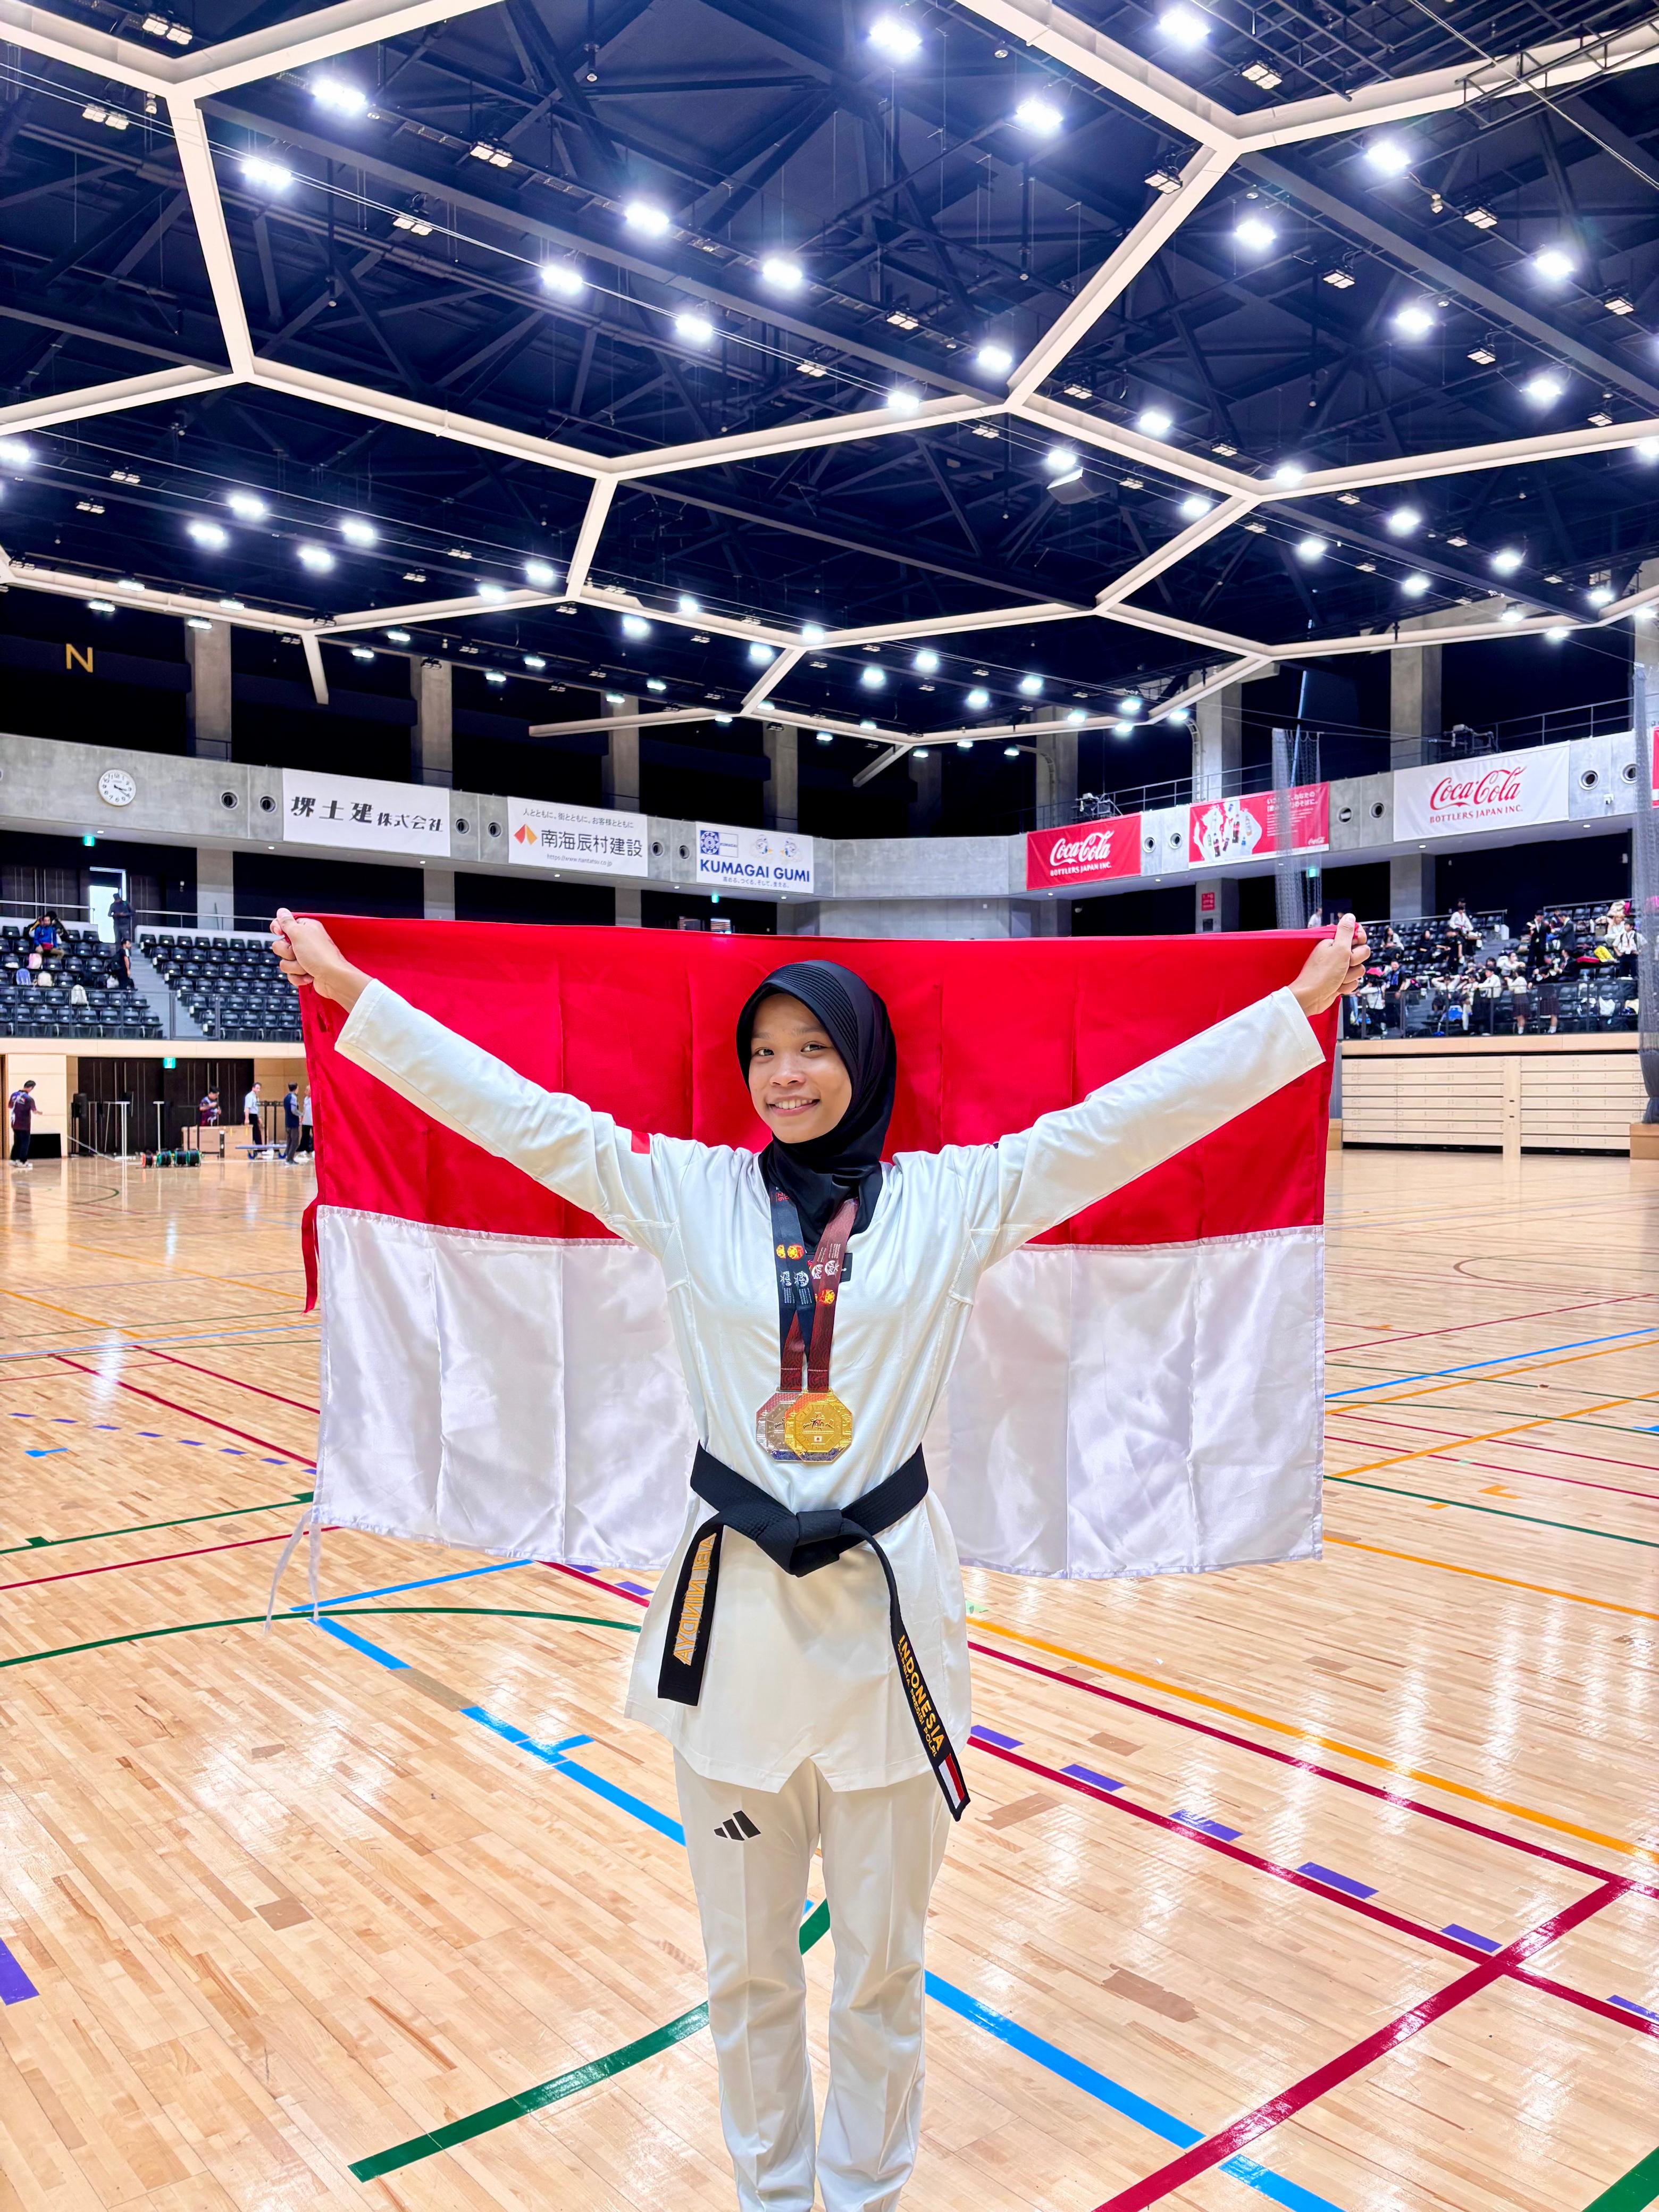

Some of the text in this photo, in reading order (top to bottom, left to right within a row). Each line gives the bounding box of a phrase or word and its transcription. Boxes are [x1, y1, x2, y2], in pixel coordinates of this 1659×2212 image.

[66, 643, 93, 673] N
[1430, 805, 1523, 824] BOTTLERS JAPAN INC.
[541, 830, 643, 857] 南海辰村建設
[700, 859, 810, 883] KUMAGAI GUMI
[1050, 866, 1080, 876] BOTTLERS
[1080, 863, 1099, 874] JAPAN
[899, 1635, 944, 1751] INDONESIA
